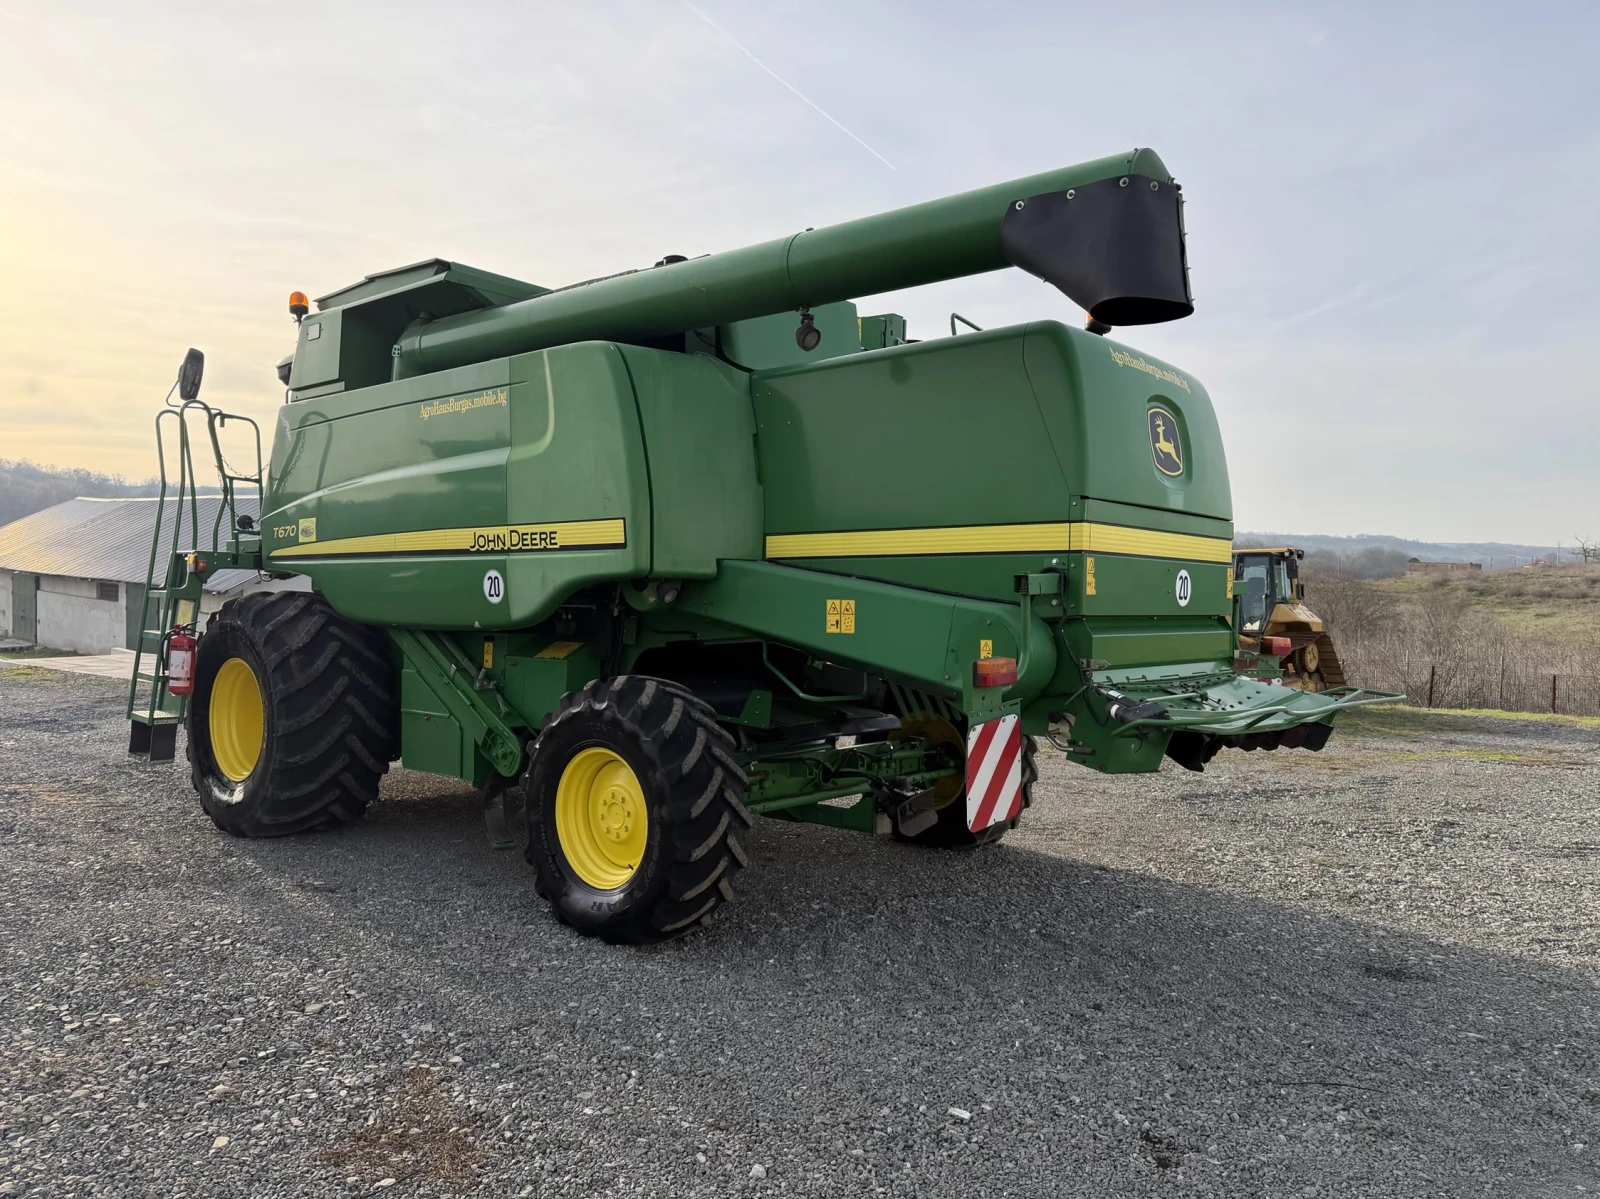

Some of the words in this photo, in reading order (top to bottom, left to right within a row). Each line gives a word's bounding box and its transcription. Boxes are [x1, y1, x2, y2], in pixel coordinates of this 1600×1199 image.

[420, 389, 506, 420] AgroHausBurgas.mobile.bg
[273, 525, 296, 538] T670
[470, 531, 507, 550] JOHN
[510, 530, 558, 548] DEERE
[487, 576, 500, 597] 20
[1178, 575, 1189, 600] 20
